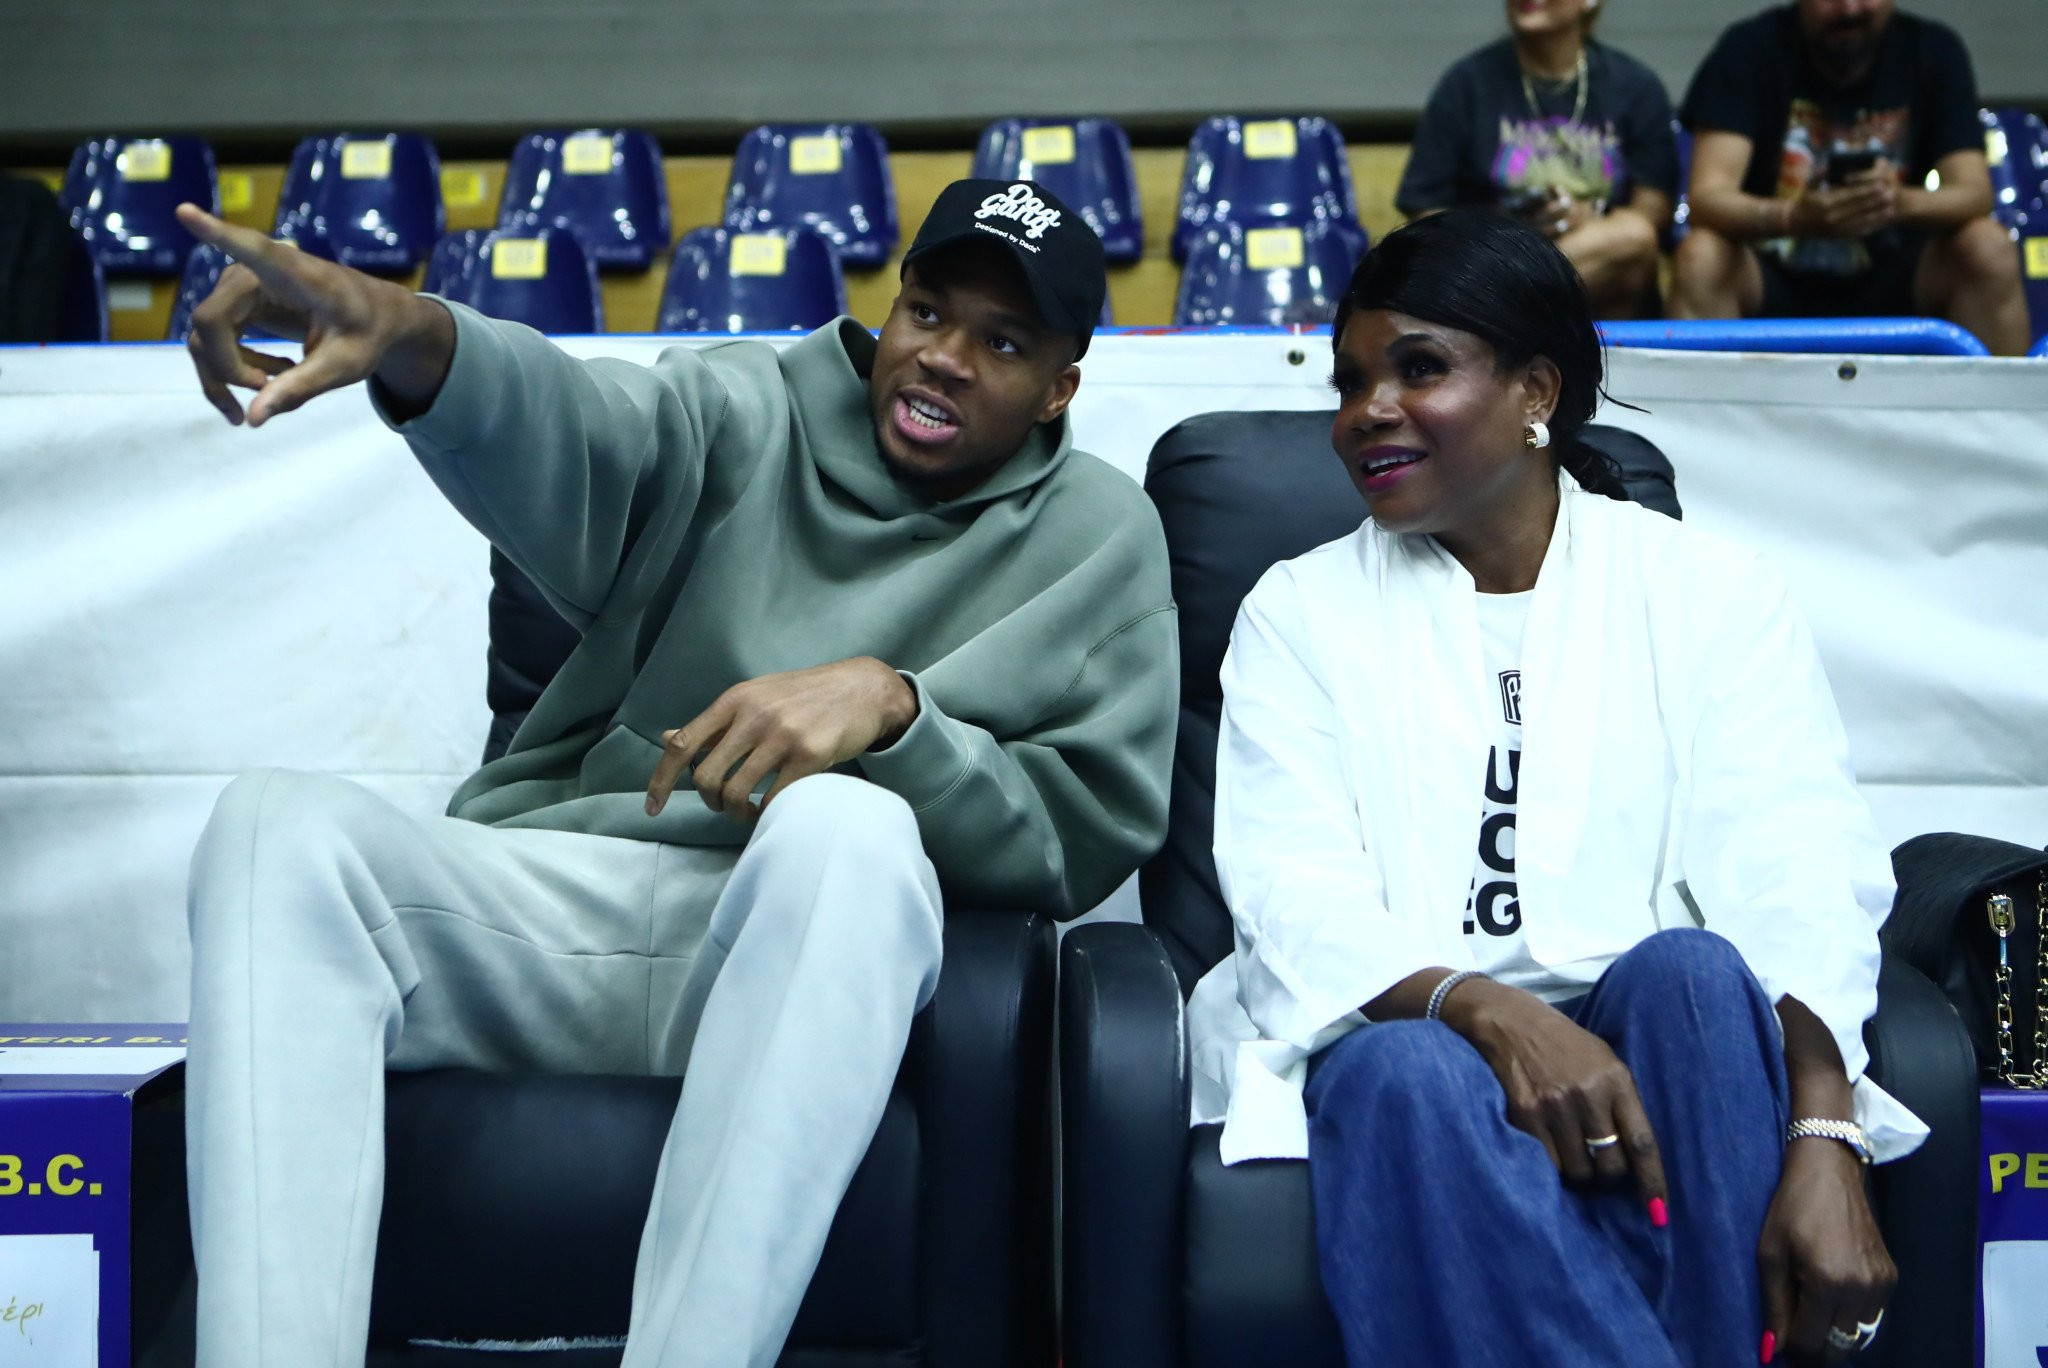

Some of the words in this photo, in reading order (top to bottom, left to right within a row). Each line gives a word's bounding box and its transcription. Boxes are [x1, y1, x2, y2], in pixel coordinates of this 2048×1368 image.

[974, 193, 1043, 239] Gang
[1008, 184, 1061, 227] Dad
[974, 222, 1008, 238] Designed
[1008, 233, 1019, 243] by
[124, 1036, 187, 1044] B.
[0, 1154, 102, 1196] B.C.
[1989, 1152, 2048, 1193] PE
[0, 1296, 44, 1336] έρι
